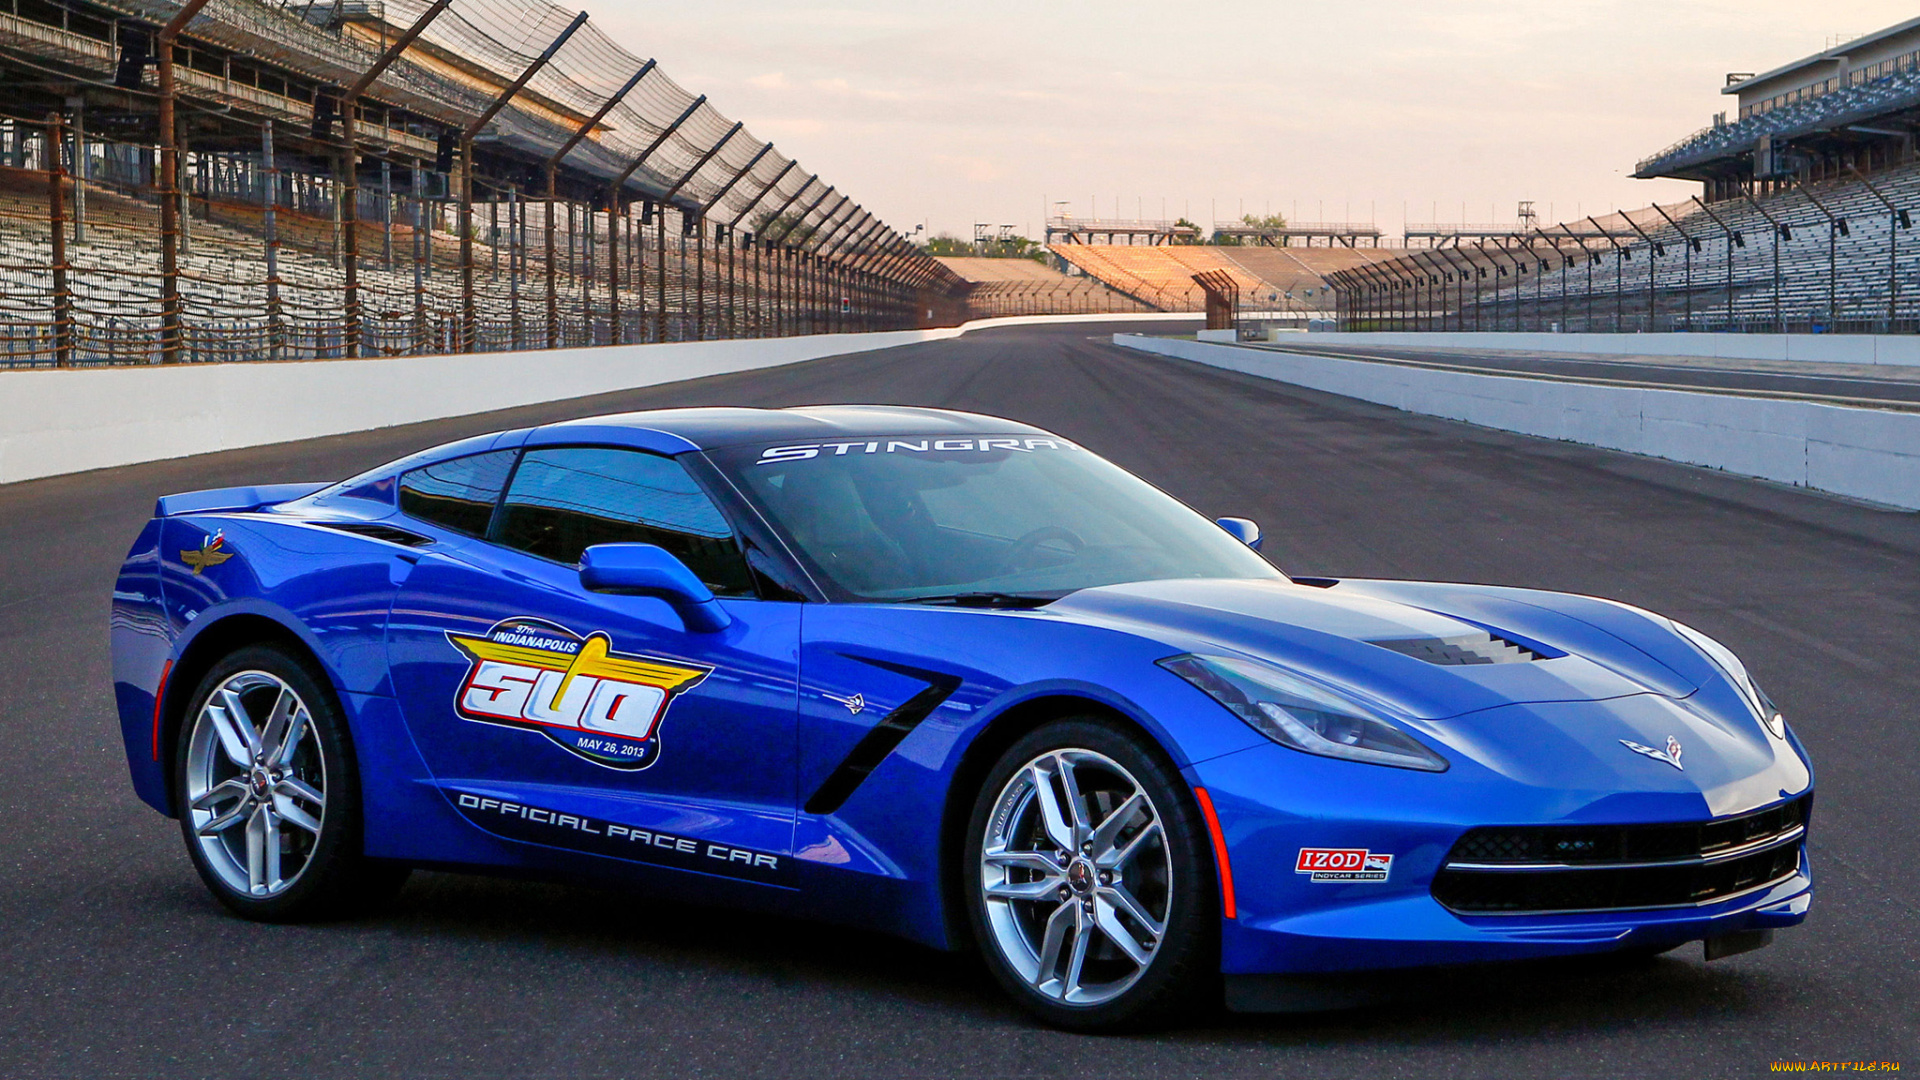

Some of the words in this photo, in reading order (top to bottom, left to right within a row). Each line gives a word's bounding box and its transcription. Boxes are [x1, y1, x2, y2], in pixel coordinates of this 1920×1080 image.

[756, 439, 1079, 465] STINGRAY
[515, 624, 536, 635] 97TH
[493, 631, 578, 653] INDIANAPOLIS
[577, 737, 603, 750] MAY
[603, 742, 619, 755] 26,
[620, 745, 645, 758] 2013
[459, 794, 600, 834] OFFICIAL
[607, 824, 697, 854] PACE
[707, 845, 778, 870] CAR
[1303, 852, 1361, 868] IZOD
